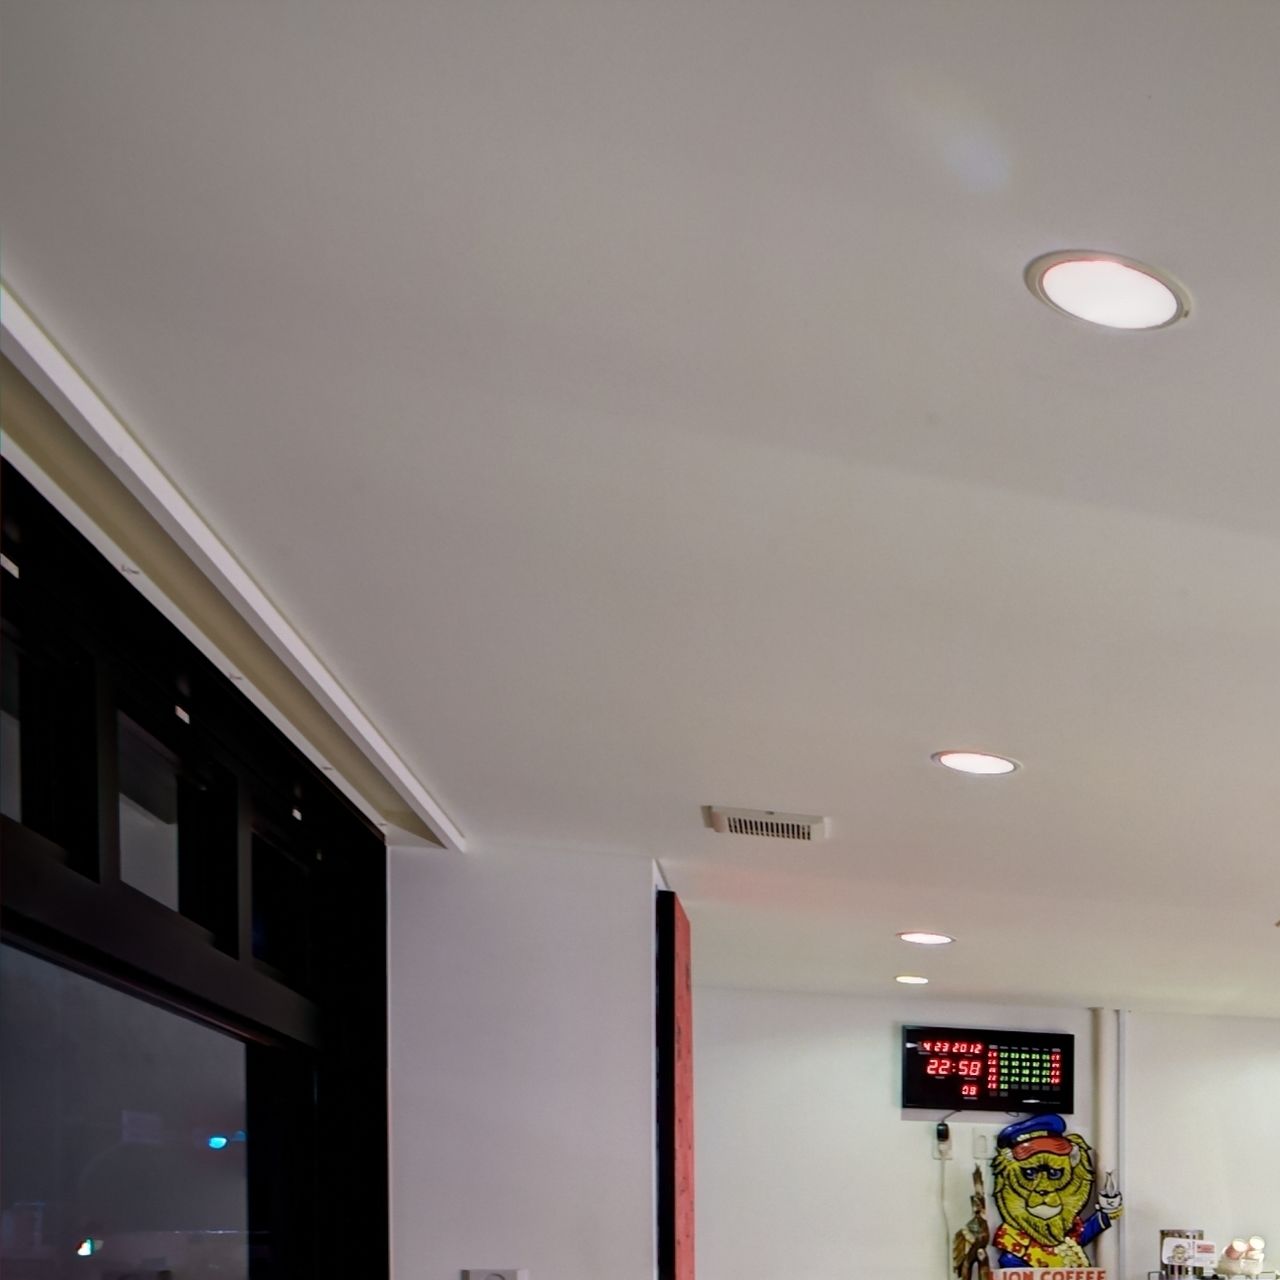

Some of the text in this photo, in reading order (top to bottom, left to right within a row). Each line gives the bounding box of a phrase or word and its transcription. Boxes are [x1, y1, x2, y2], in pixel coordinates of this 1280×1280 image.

[934, 1042, 949, 1052] 23
[952, 1042, 982, 1054] 2012
[926, 1059, 982, 1077] 22:58
